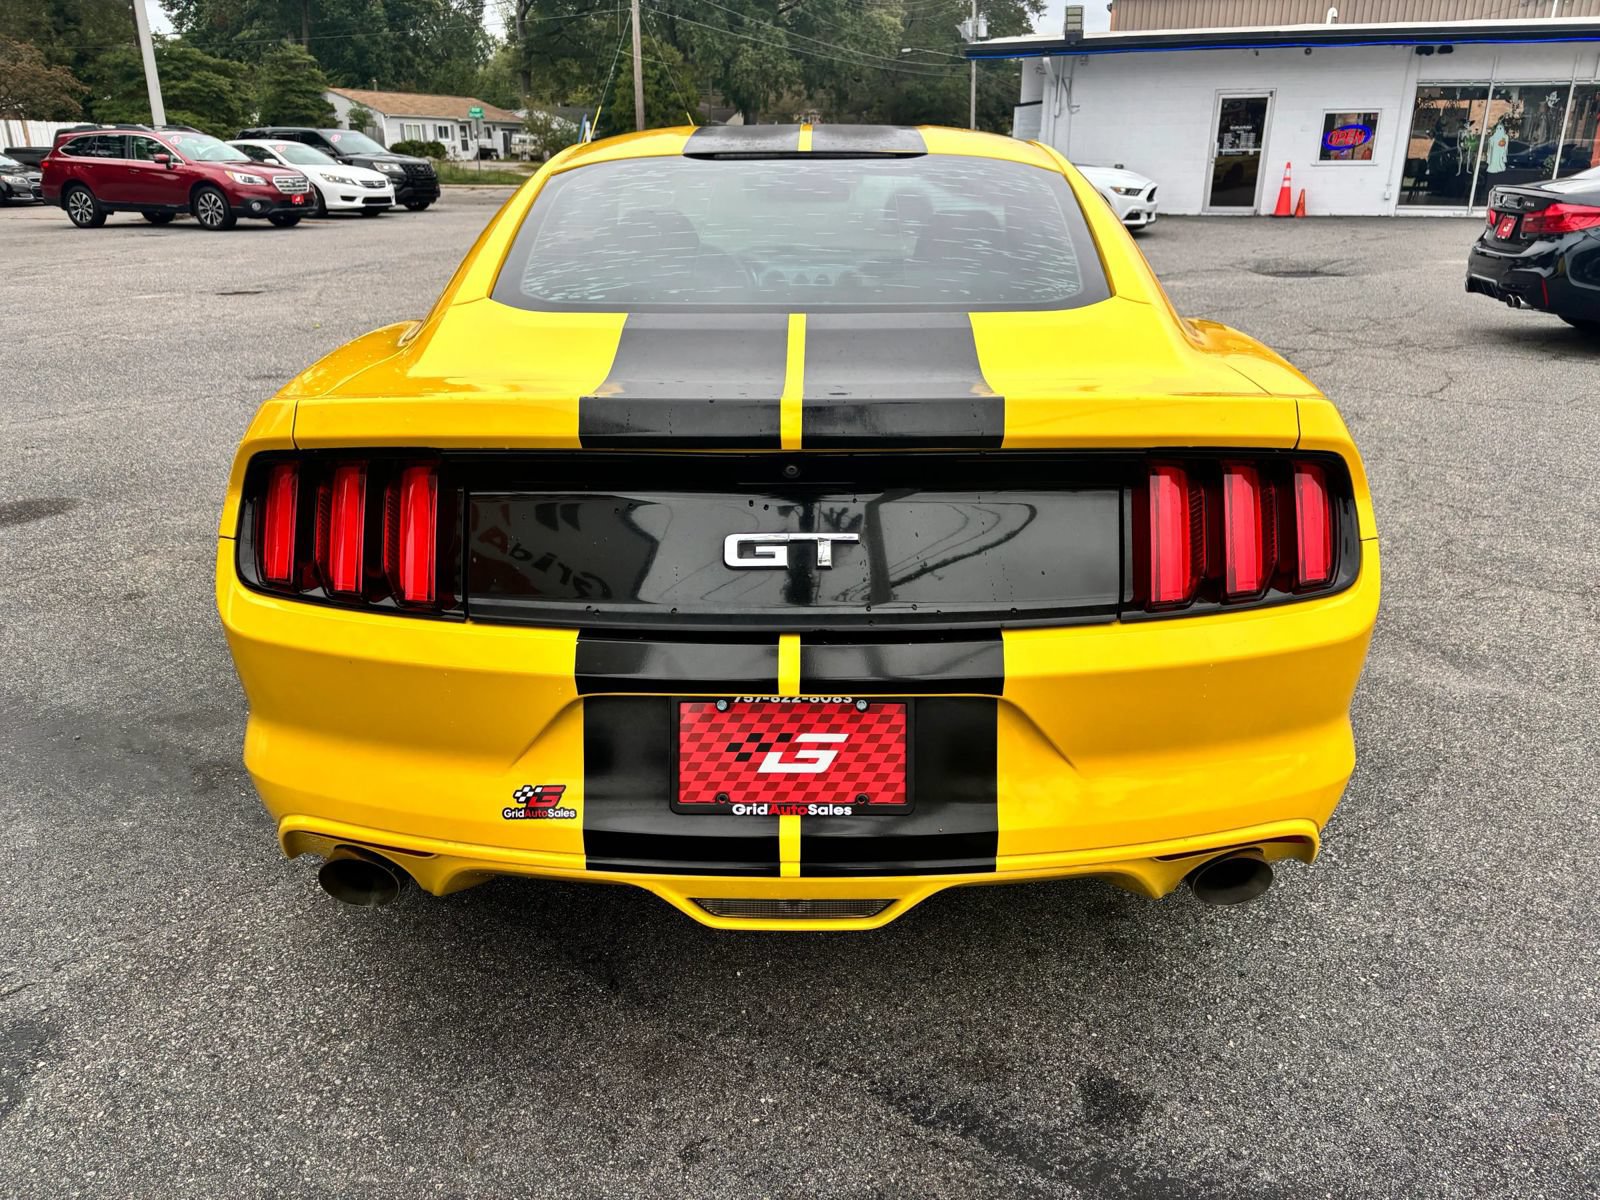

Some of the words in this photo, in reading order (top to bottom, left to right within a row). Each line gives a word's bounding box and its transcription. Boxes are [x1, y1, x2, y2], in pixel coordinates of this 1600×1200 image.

[1328, 128, 1365, 146] OPEN
[723, 533, 860, 569] GT
[503, 808, 576, 818] GridAutoSales
[731, 803, 853, 816] GridAutoSales
